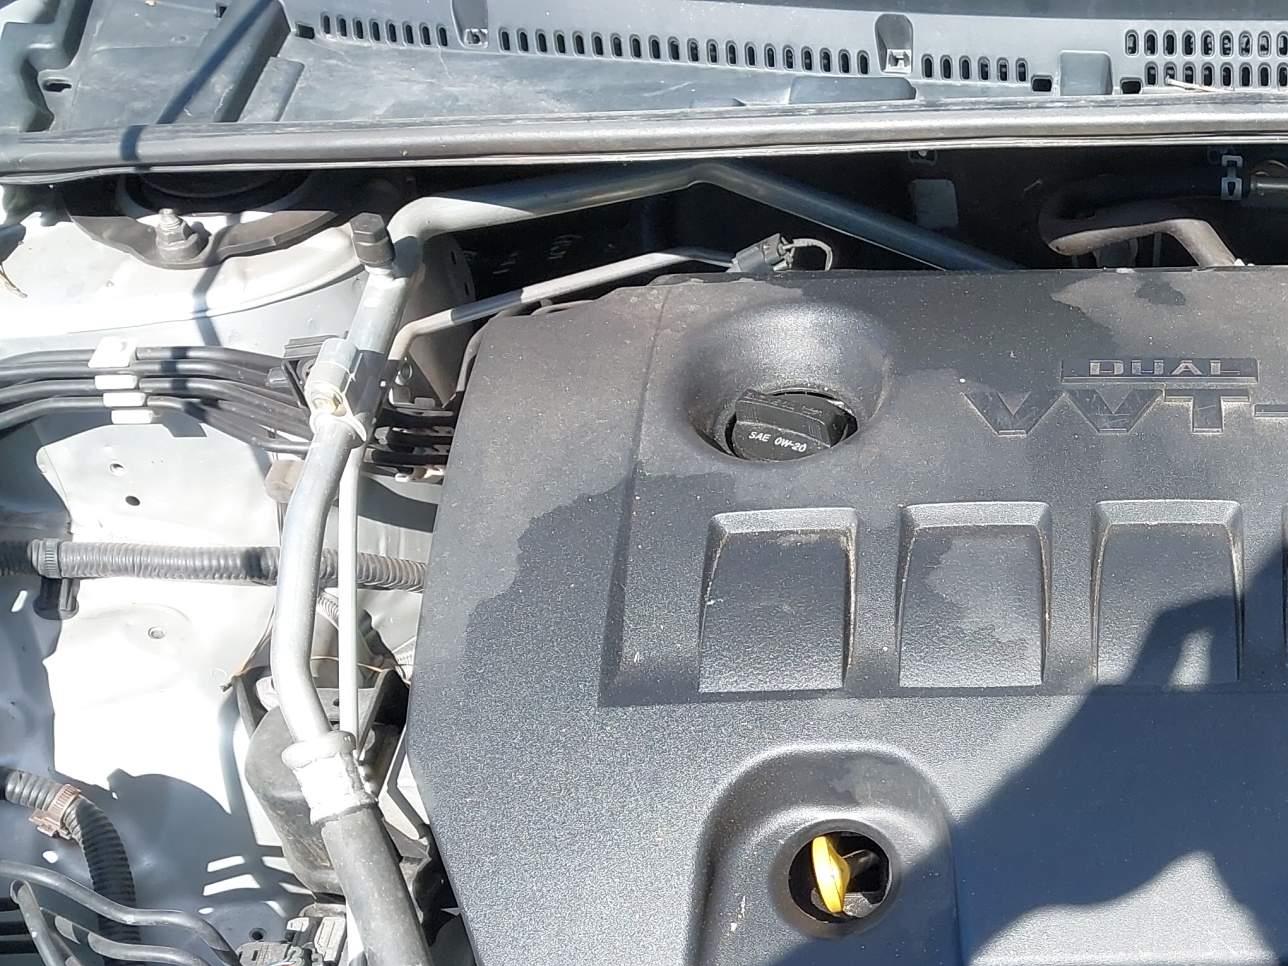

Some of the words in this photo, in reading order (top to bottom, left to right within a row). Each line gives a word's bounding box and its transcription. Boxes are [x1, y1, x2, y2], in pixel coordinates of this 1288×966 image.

[1089, 359, 1241, 376] DUAL
[748, 431, 772, 442] SAE
[774, 437, 807, 453] 0W-20
